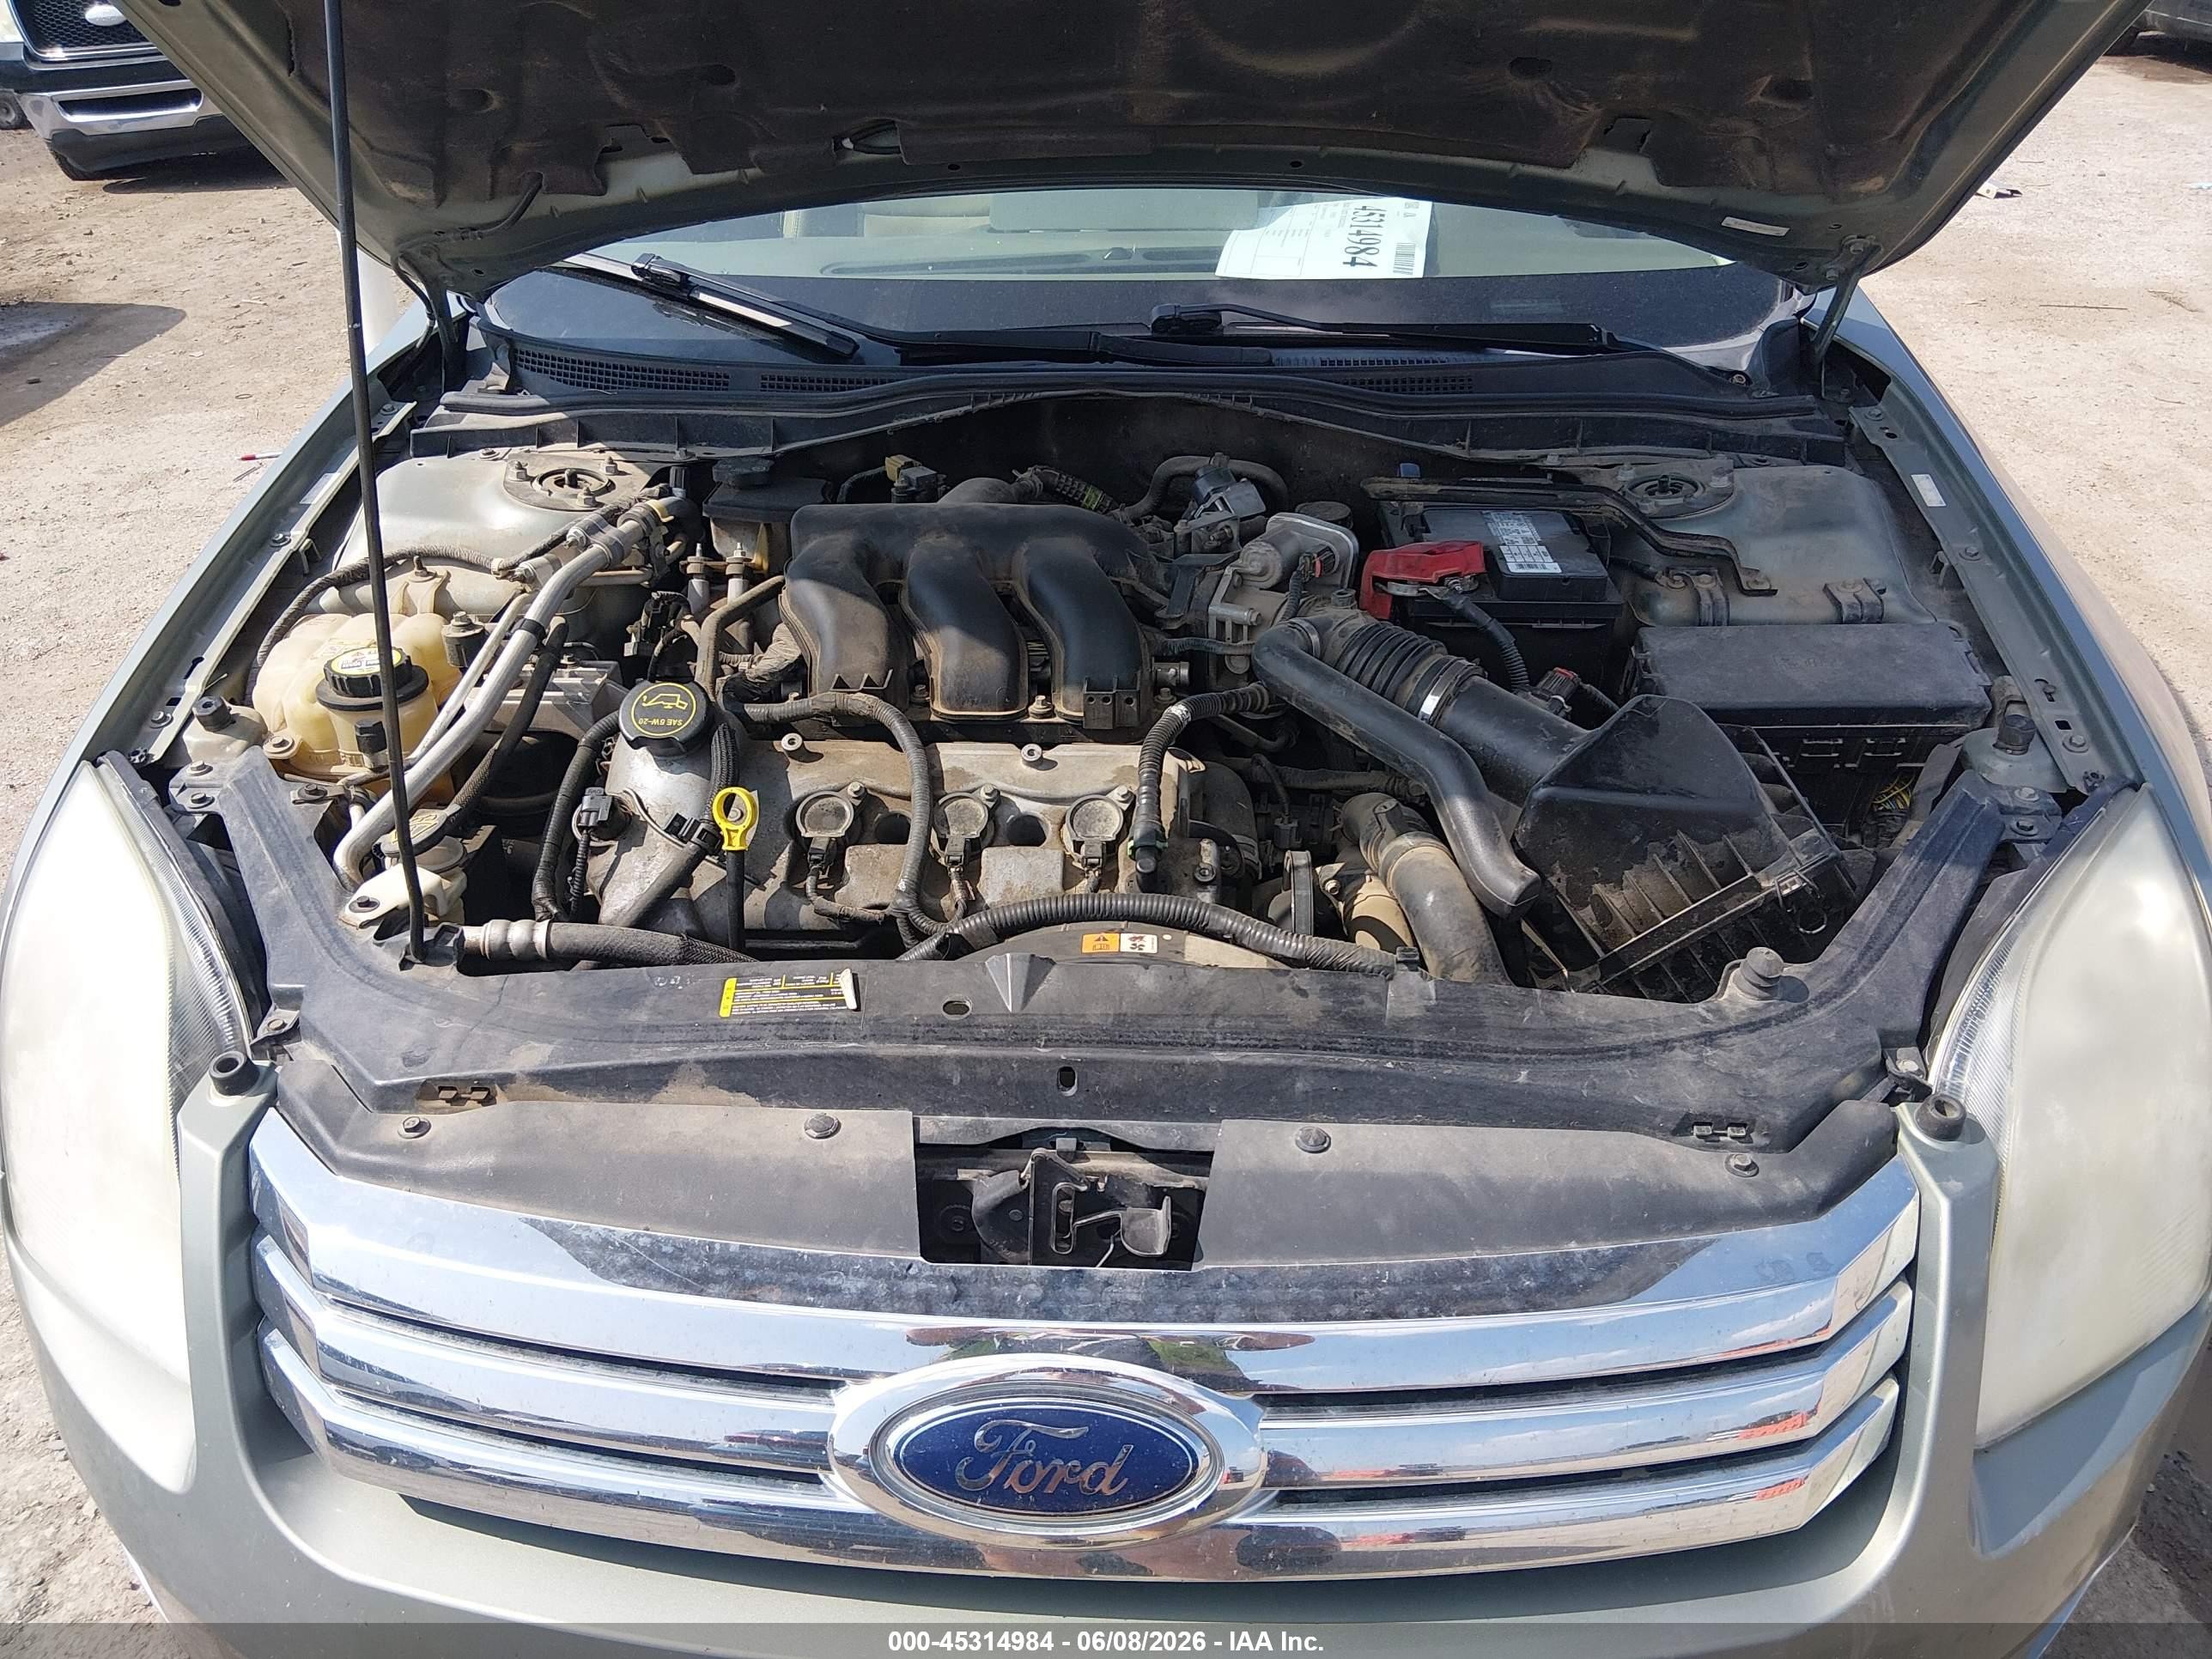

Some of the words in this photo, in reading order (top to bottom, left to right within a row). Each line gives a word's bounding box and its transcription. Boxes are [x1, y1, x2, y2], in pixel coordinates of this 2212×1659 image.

[1342, 205, 1388, 268] 45314984
[638, 717, 665, 726] 5W-20
[665, 718, 684, 726] SAE
[955, 1419, 1134, 1496] Ford
